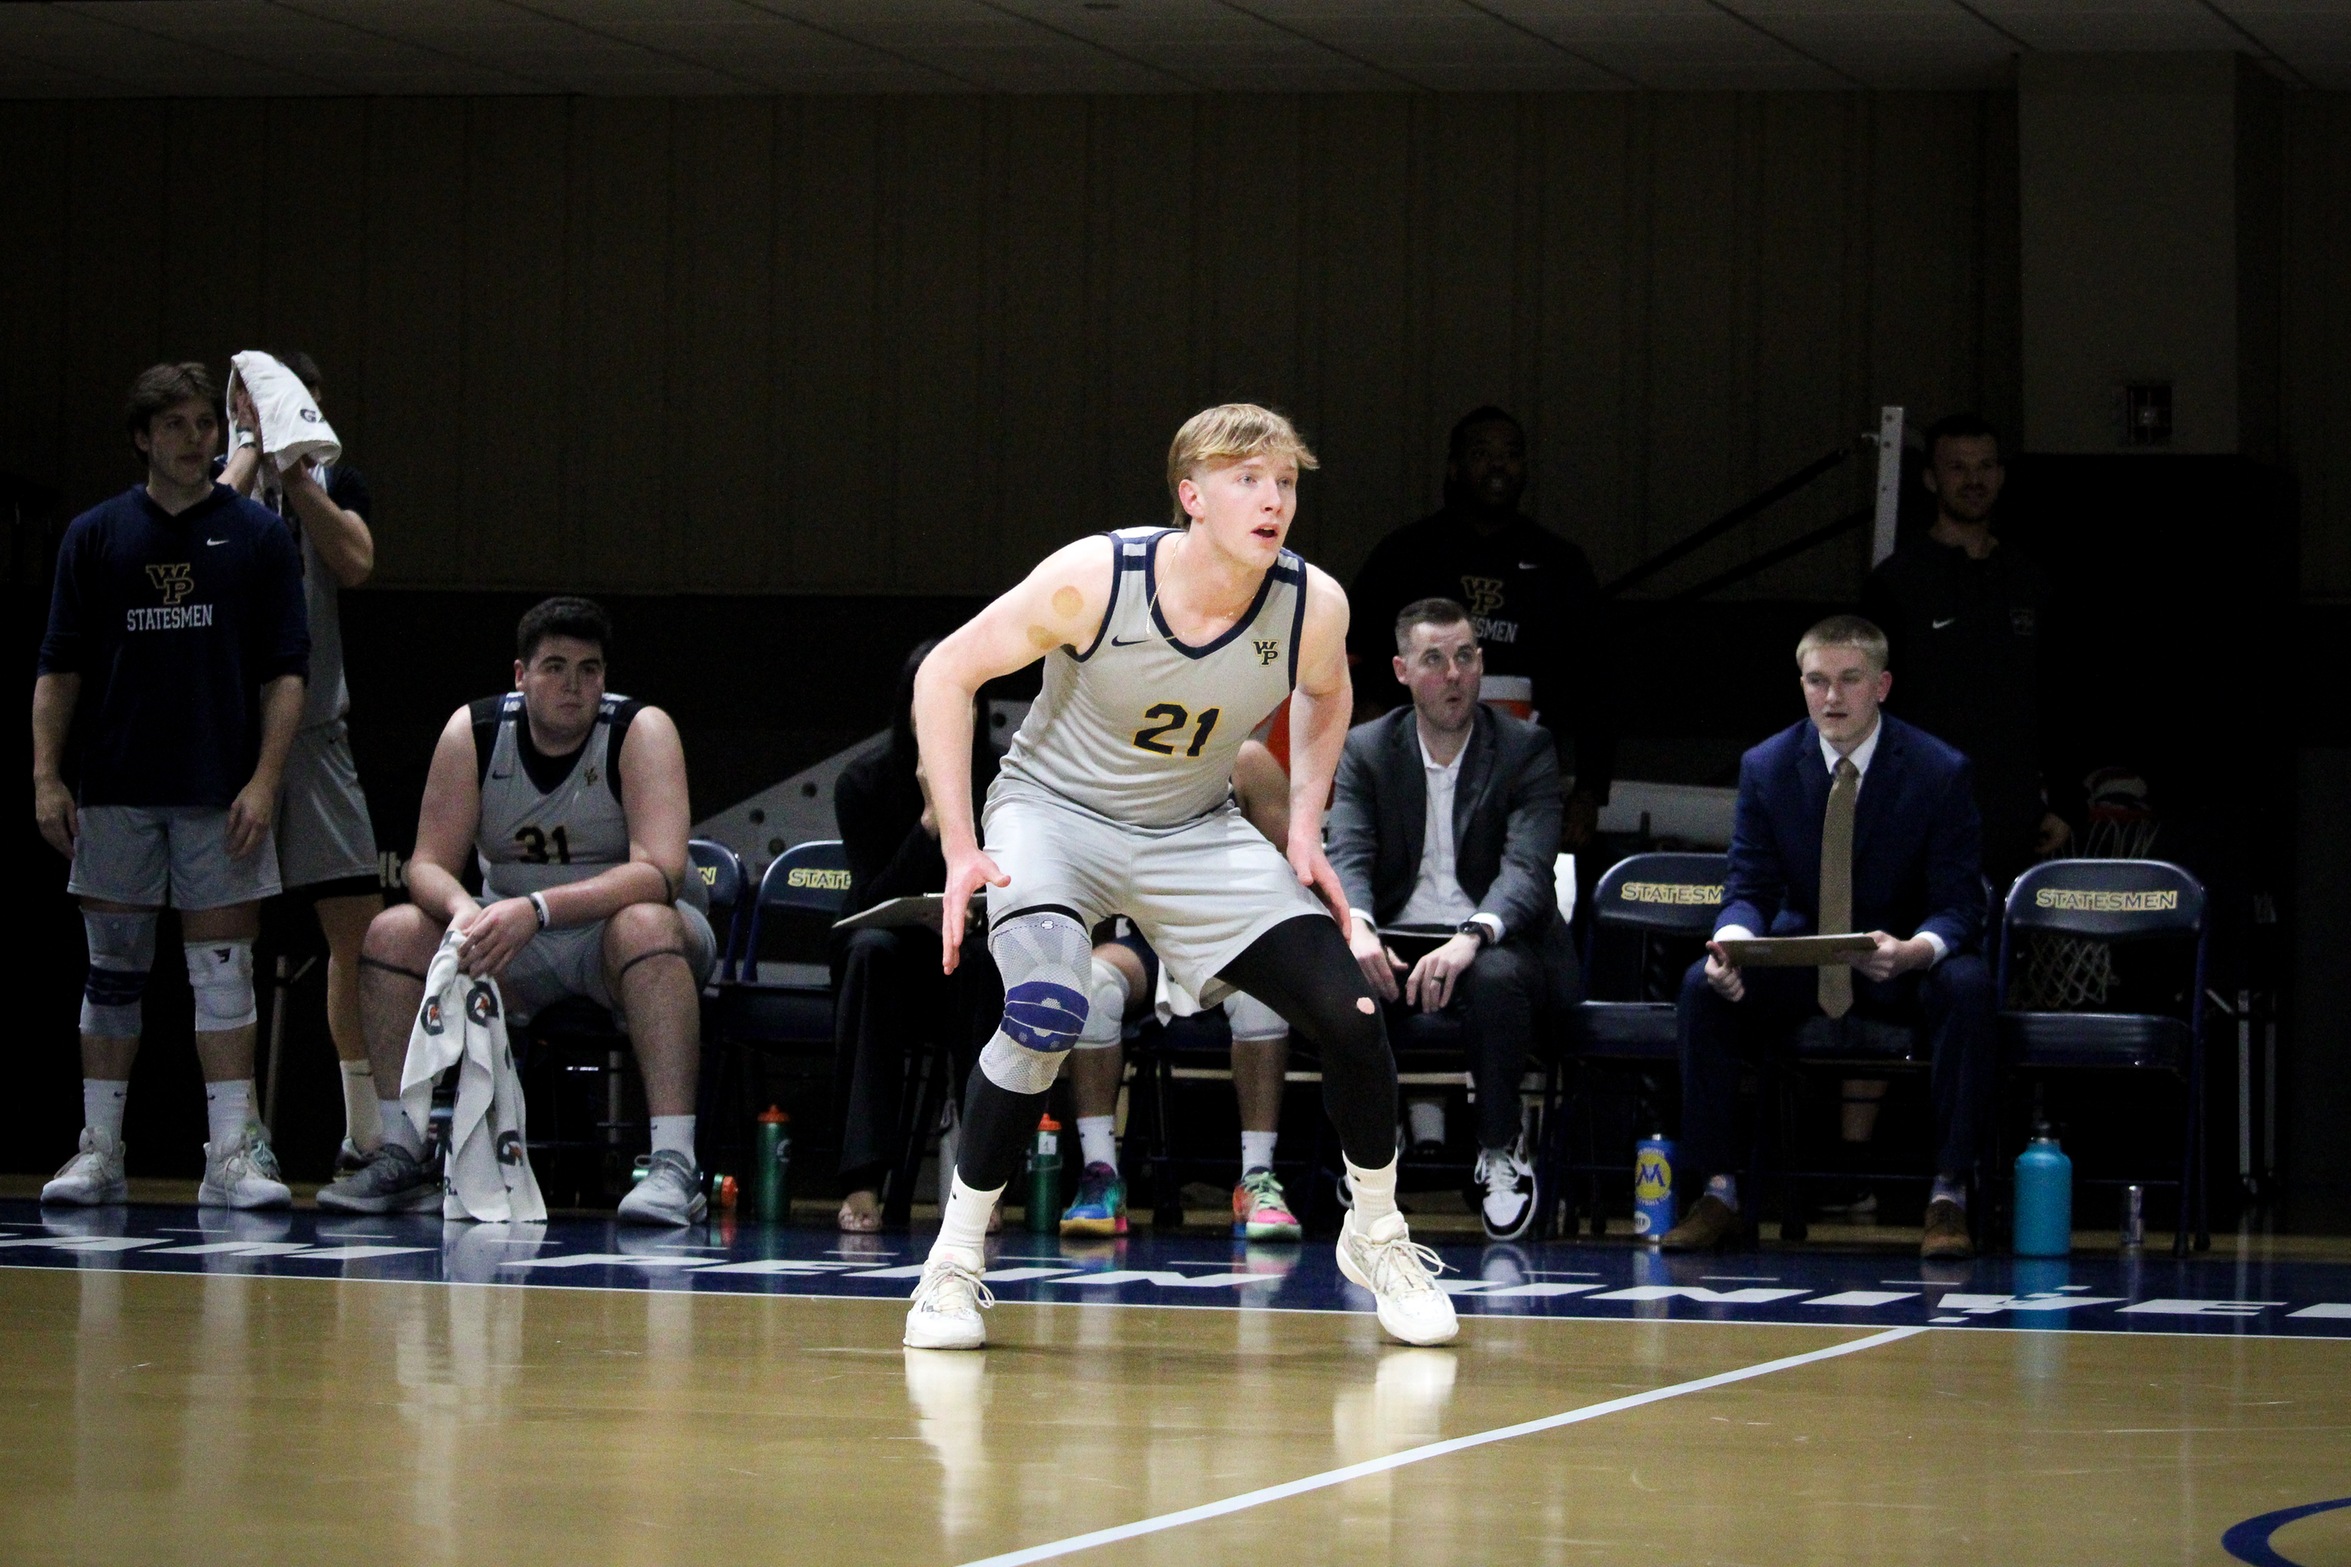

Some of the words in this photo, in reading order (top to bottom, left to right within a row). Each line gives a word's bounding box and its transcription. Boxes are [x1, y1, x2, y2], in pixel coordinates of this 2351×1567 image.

[145, 562, 195, 605] WP
[126, 604, 214, 632] STATESMEN
[1253, 641, 1278, 666] WP
[1132, 702, 1221, 758] 21
[515, 826, 571, 864] 31
[2035, 888, 2178, 911] STATESMEN
